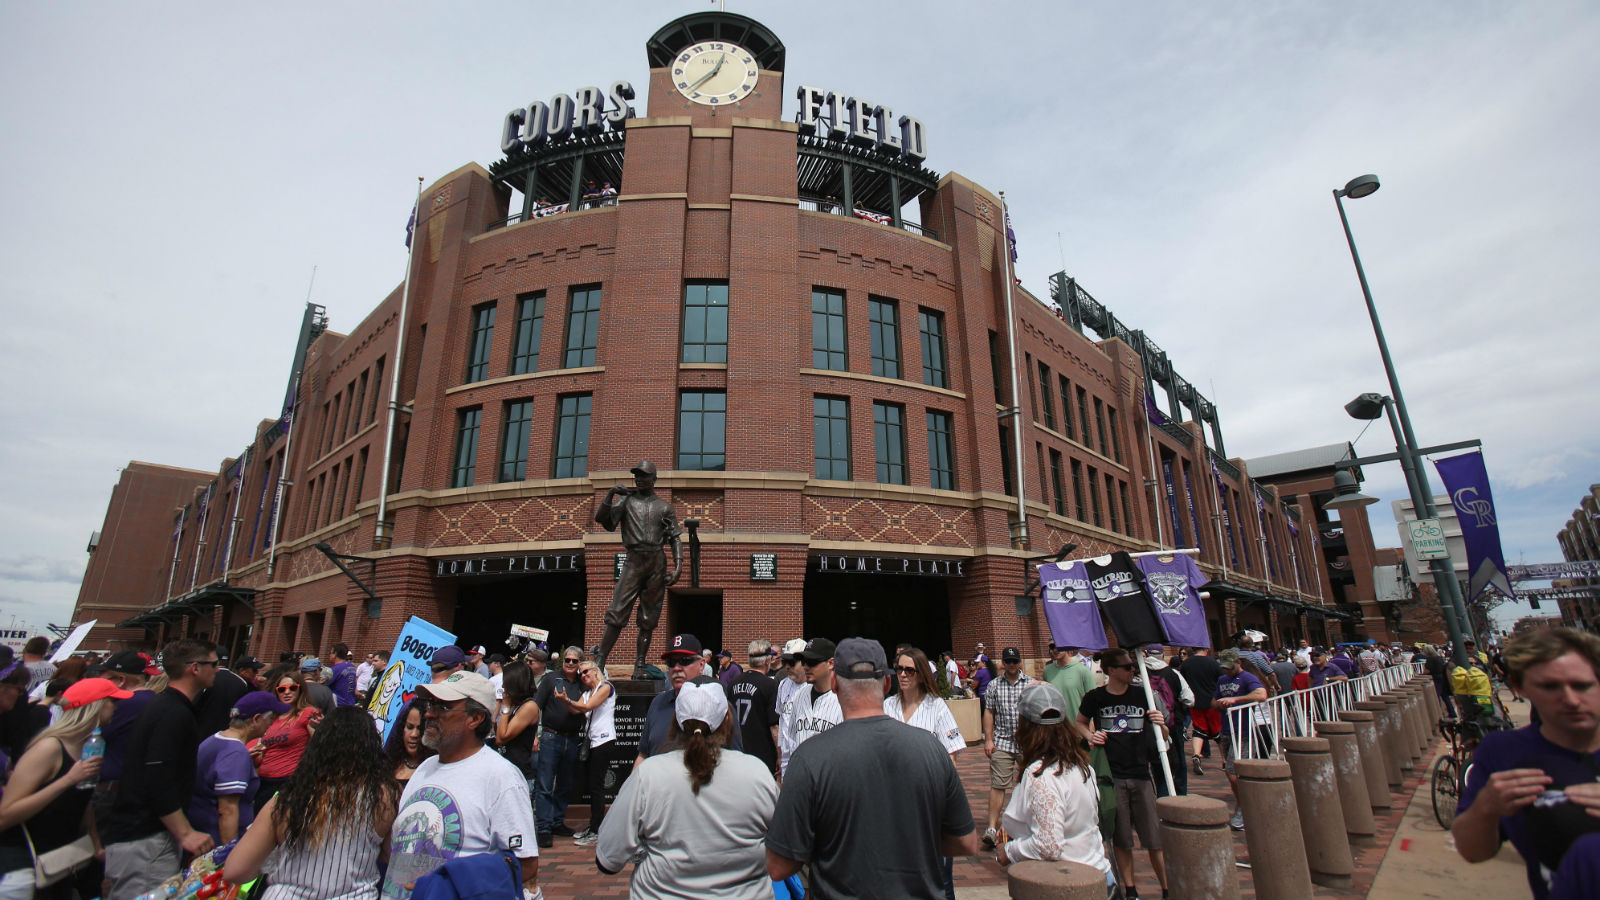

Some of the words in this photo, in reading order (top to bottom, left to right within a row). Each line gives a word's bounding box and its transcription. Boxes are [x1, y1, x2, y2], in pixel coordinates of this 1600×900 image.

[679, 53, 691, 63] 10
[742, 84, 751, 92] 4
[710, 96, 719, 104] 6
[728, 93, 738, 101] 5
[500, 80, 635, 157] COORS
[797, 85, 926, 160] FIELD
[1415, 537, 1445, 548] PARKING
[437, 559, 488, 576] HOME
[508, 555, 577, 571] PLATE
[820, 556, 882, 572] HOME
[903, 559, 963, 576] PLATE
[1091, 571, 1134, 590] COLORADO
[1560, 570, 1585, 579] APRIL
[1046, 578, 1091, 589] COLORADO
[673, 635, 682, 647] B
[733, 682, 757, 696] HELTON
[735, 698, 751, 726] 17
[1100, 704, 1145, 717] COLORADO
